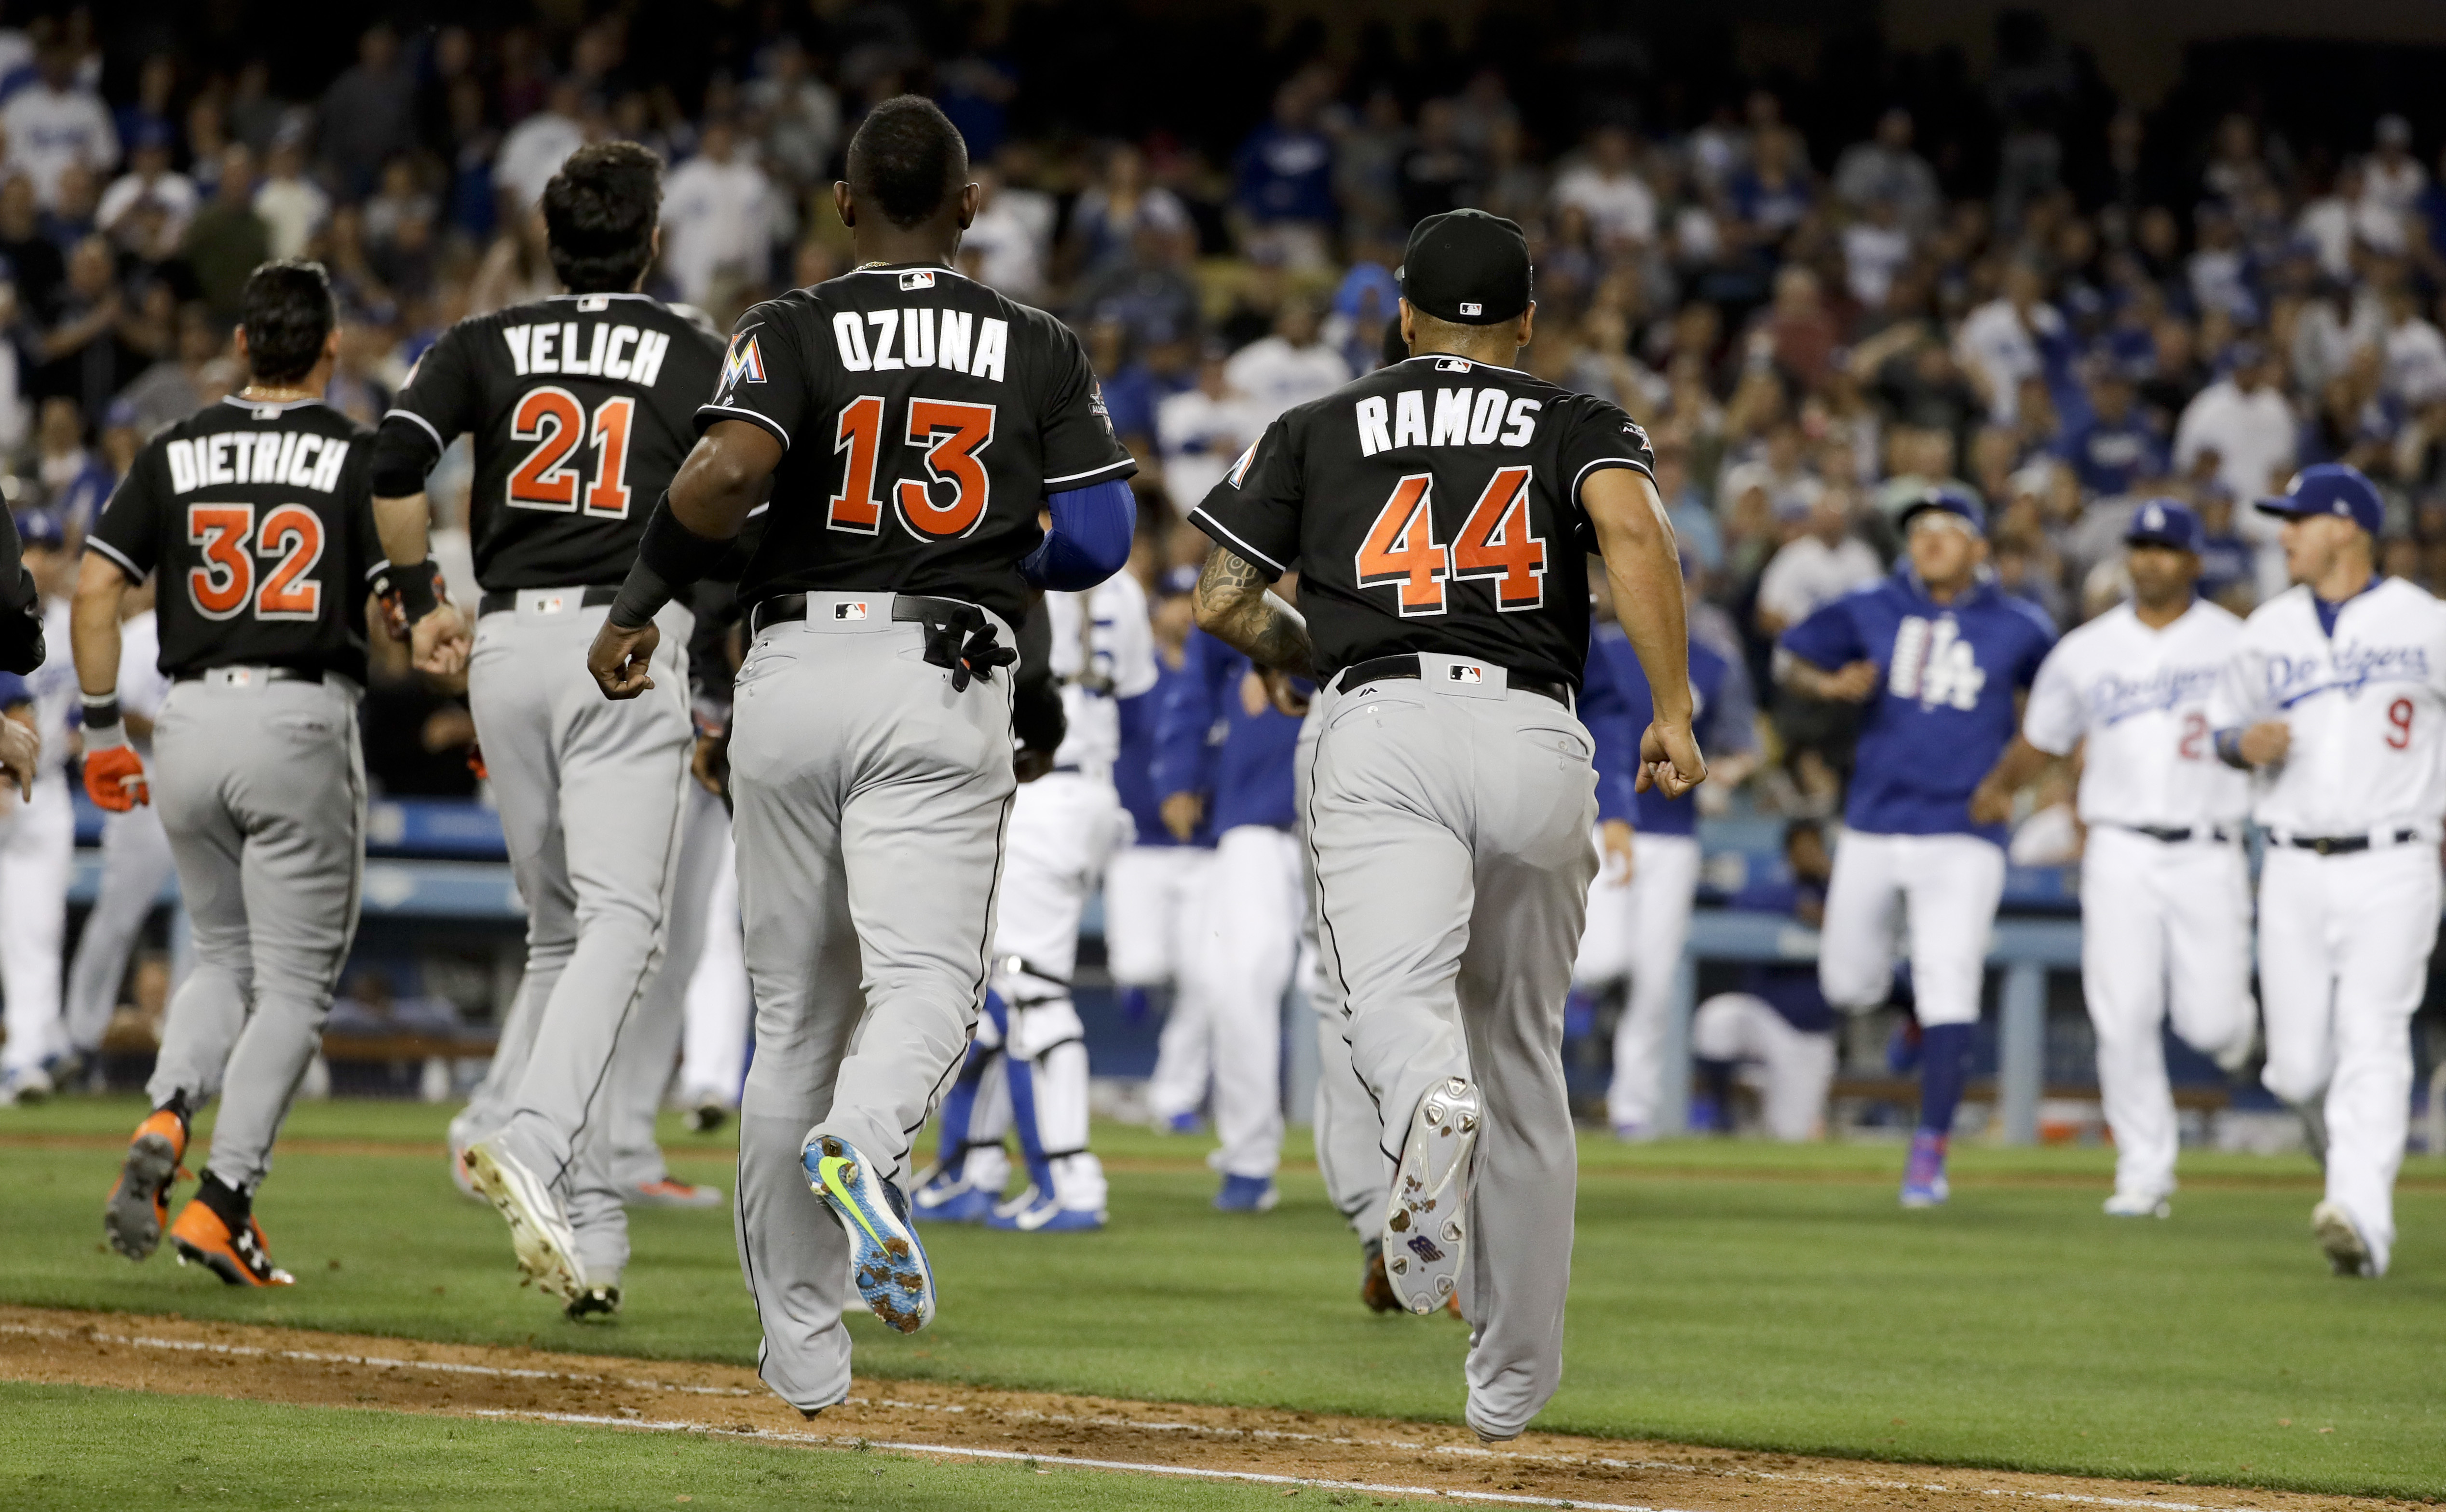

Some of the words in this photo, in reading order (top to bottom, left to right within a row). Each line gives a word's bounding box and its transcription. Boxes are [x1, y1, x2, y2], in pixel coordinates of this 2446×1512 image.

[503, 322, 670, 387] YELICH
[832, 308, 1008, 382] OZUNA
[505, 386, 635, 520] 21
[1356, 388, 1542, 458] RAMOS
[166, 432, 350, 495] DIETRICH
[826, 395, 997, 543] 13
[188, 502, 325, 621] 32
[1355, 465, 1548, 617] 44
[2265, 637, 2430, 710] Dodgers
[2178, 710, 2214, 762] 2
[2385, 697, 2414, 751] 9
